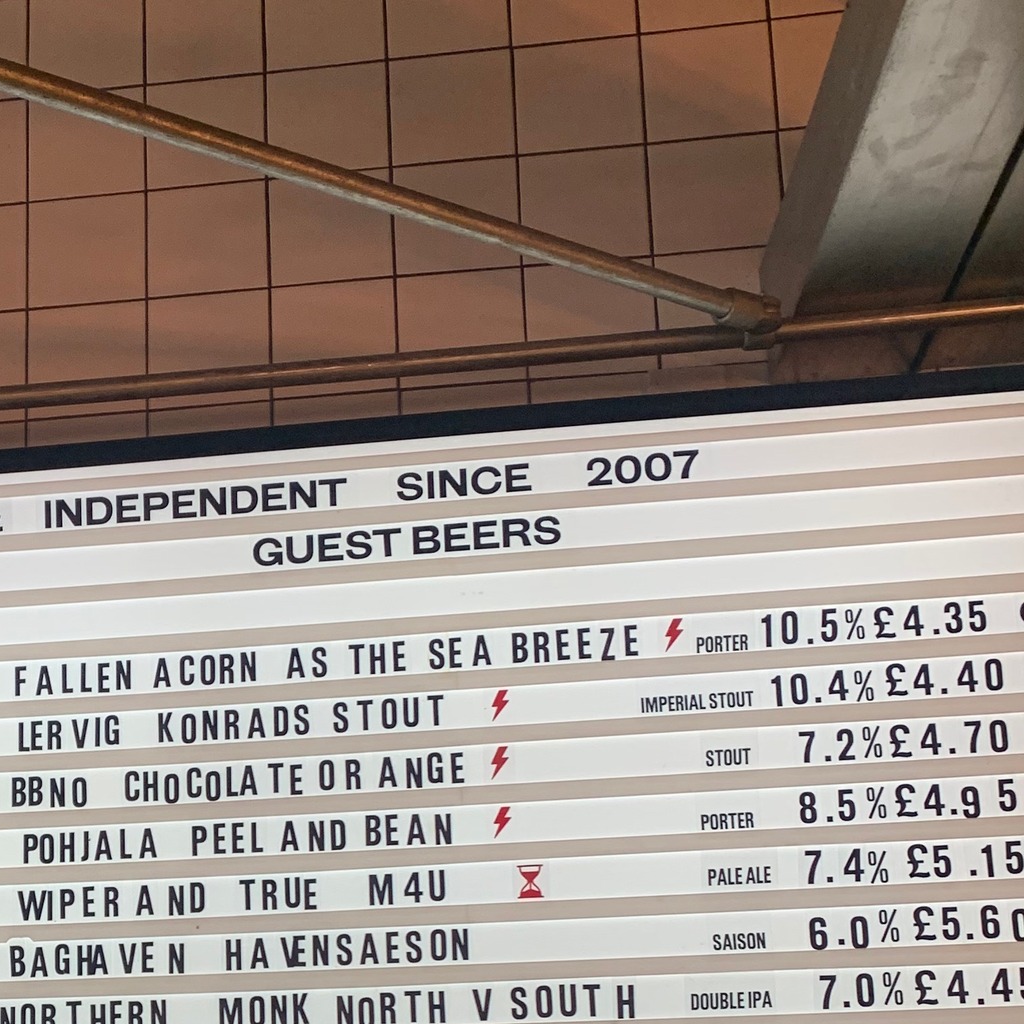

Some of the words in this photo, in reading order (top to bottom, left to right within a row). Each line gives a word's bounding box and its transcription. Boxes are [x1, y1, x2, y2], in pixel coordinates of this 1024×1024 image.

[44, 477, 348, 529] INDEPENDENT
[396, 462, 533, 501] SINCE
[586, 449, 699, 487] 2007
[252, 527, 402, 567] GUEST
[412, 515, 561, 555] BEERS
[14, 659, 132, 697] FALLEN
[153, 651, 257, 689] ACORN
[286, 646, 328, 679] AS
[348, 640, 406, 675] THE
[428, 634, 492, 670] SEA
[511, 624, 639, 664] BREEZE
[696, 634, 748, 654] PORTER
[873, 600, 987, 639] £4.35
[332, 694, 444, 734] STOUT
[640, 694, 707, 714] IMPERIAL
[708, 690, 754, 709] STOUT
[11, 776, 88, 808] BBNO
[705, 747, 751, 767] STOUT
[23, 827, 158, 865] POHJALA
[191, 822, 264, 857] PEEL
[280, 819, 347, 852] AND
[365, 813, 452, 847] BEAN
[239, 876, 318, 911] TRUE
[368, 869, 446, 906] M4U
[712, 932, 767, 951] SAISON
[690, 991, 745, 1011] DOUBLE
